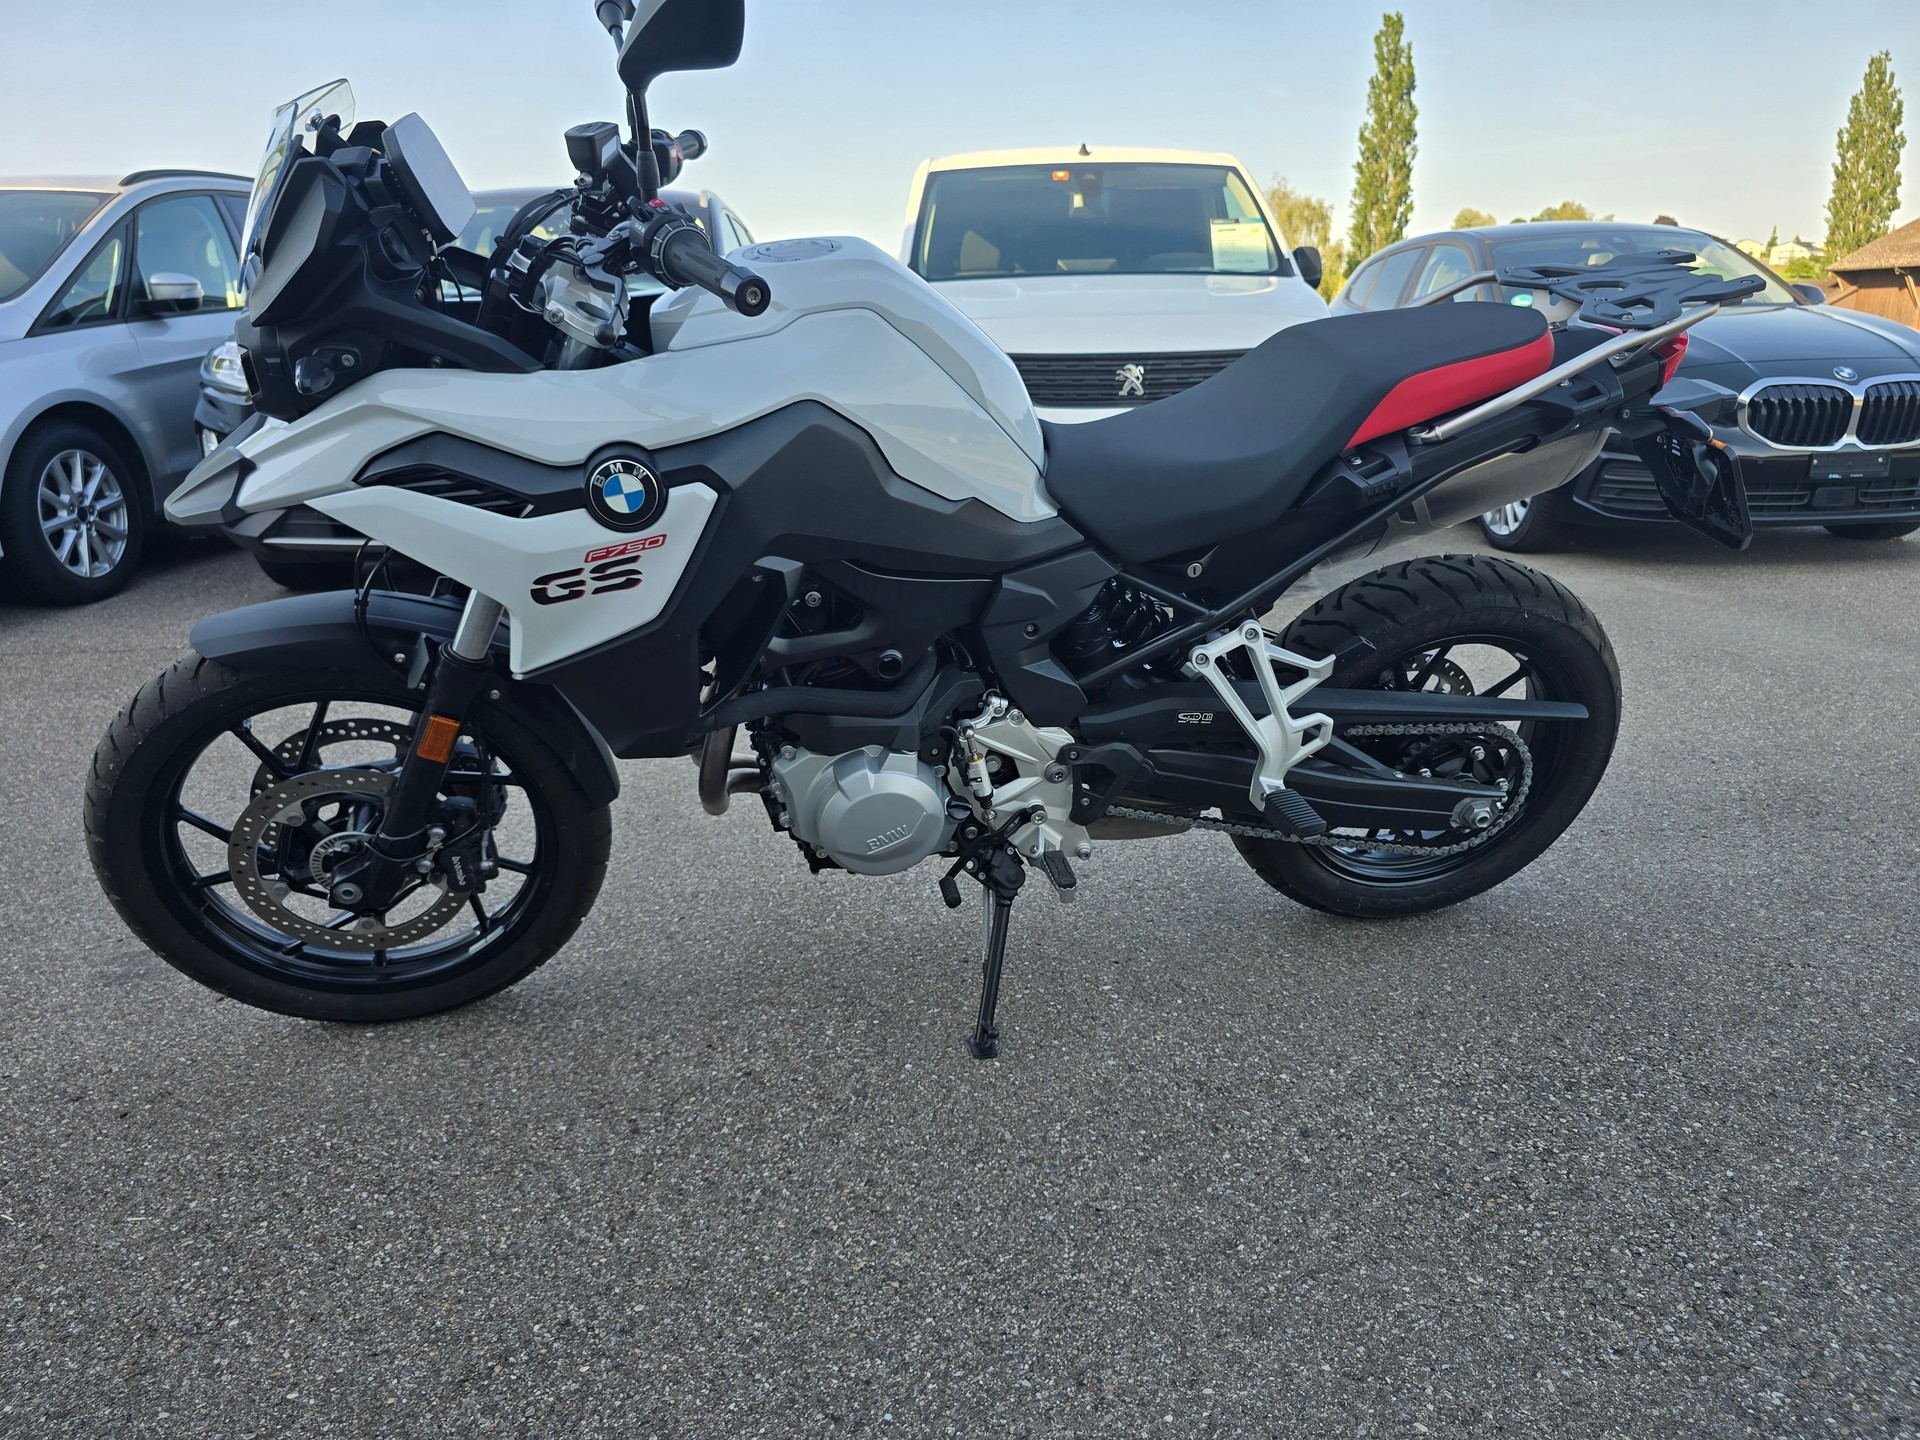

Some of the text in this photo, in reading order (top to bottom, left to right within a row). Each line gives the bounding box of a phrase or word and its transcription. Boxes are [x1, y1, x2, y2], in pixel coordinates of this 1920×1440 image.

[594, 462, 648, 488] BMW
[586, 536, 665, 562] F750
[530, 555, 643, 605] GS
[866, 824, 909, 850] BMW
